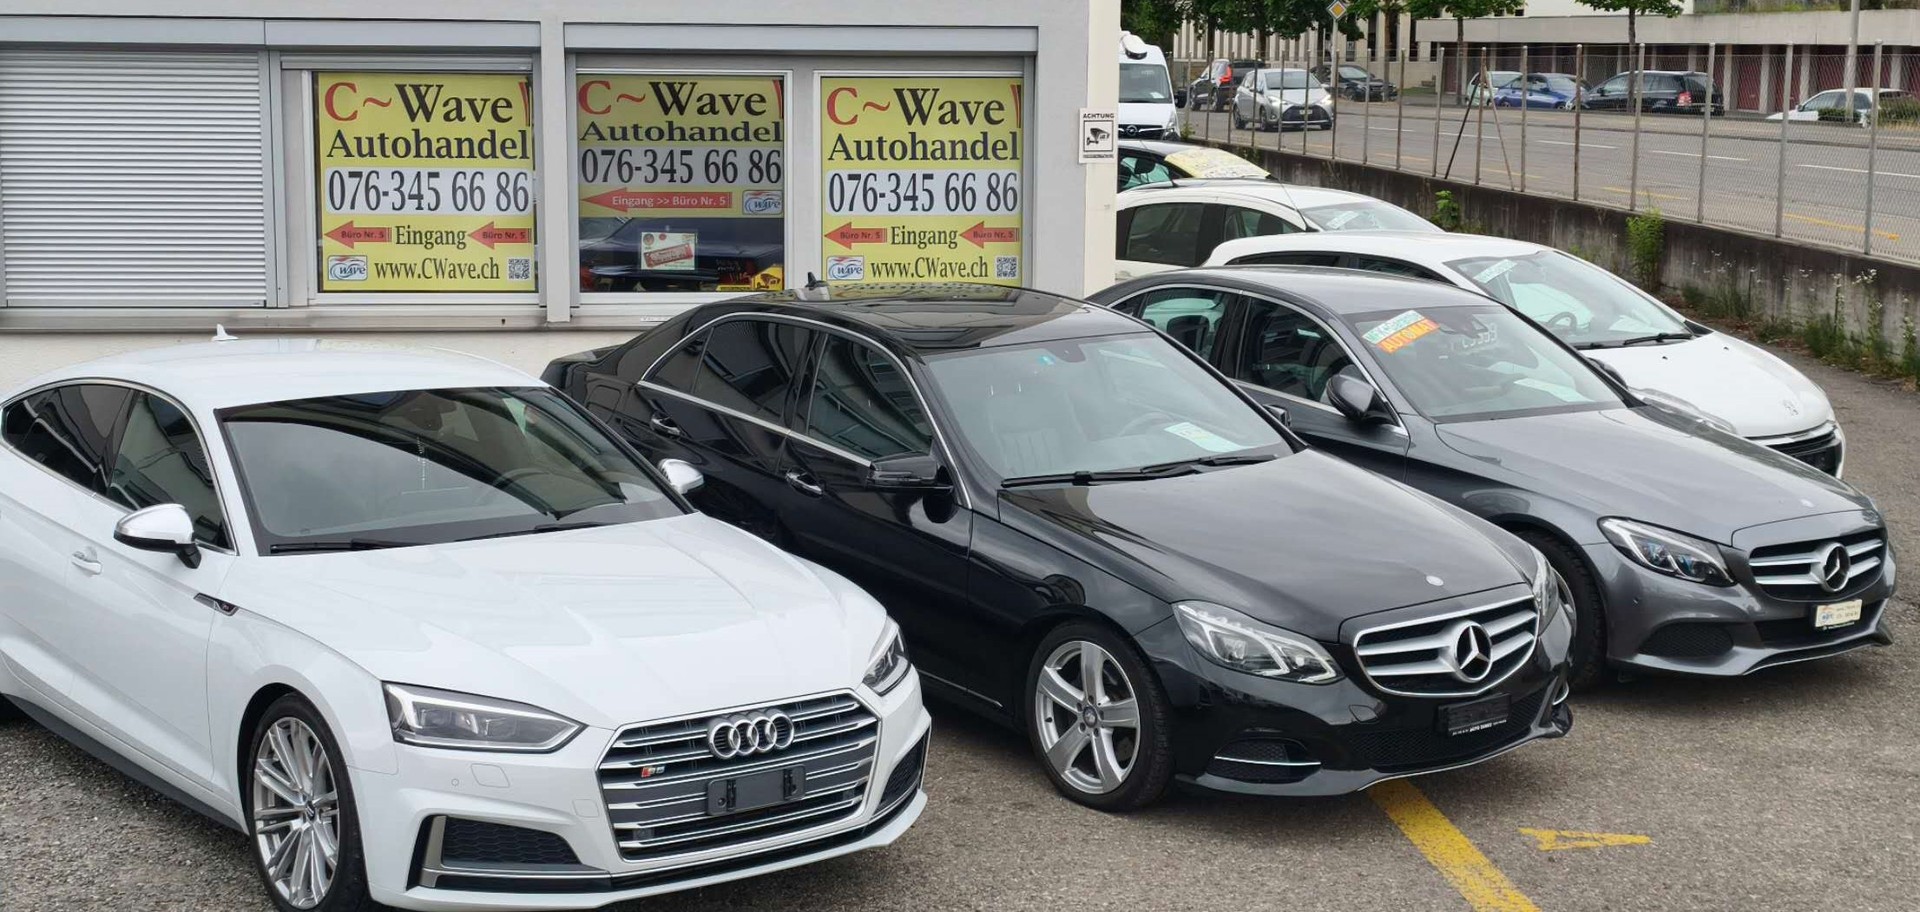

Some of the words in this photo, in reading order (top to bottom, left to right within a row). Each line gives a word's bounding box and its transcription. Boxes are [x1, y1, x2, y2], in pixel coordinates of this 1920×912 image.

[580, 120, 783, 142] Autohandel
[326, 128, 530, 160] Autohandel
[827, 131, 1020, 161] Autohandel
[581, 149, 693, 184] 076-345
[704, 149, 738, 184] 66
[748, 149, 782, 184] 86
[328, 170, 441, 211] 076-345
[451, 171, 486, 211] 66
[496, 171, 529, 212] 86
[612, 196, 654, 208] Eingang
[672, 195, 698, 205] Büro
[700, 196, 717, 205] Nr.
[720, 196, 726, 205] 5
[828, 172, 934, 212] 076-345
[944, 172, 977, 212] 66
[986, 172, 1018, 212] 86
[341, 230, 362, 239] Büro
[364, 231, 377, 239] Nr.
[395, 225, 467, 250] Eingang
[482, 230, 503, 239] Büro
[504, 231, 518, 239] Nr.
[520, 231, 526, 239] 5
[840, 231, 860, 239] Büro
[862, 231, 874, 239] Nr.
[876, 231, 881, 239] 5
[890, 225, 958, 249] Eingang
[972, 230, 992, 239] Büro
[994, 230, 1006, 239] Nr.
[1009, 230, 1014, 238] 5
[374, 257, 500, 280] www.CWave.ch
[870, 256, 989, 278] www.CWave.ch
[1380, 318, 1437, 353] AUTOMAT
